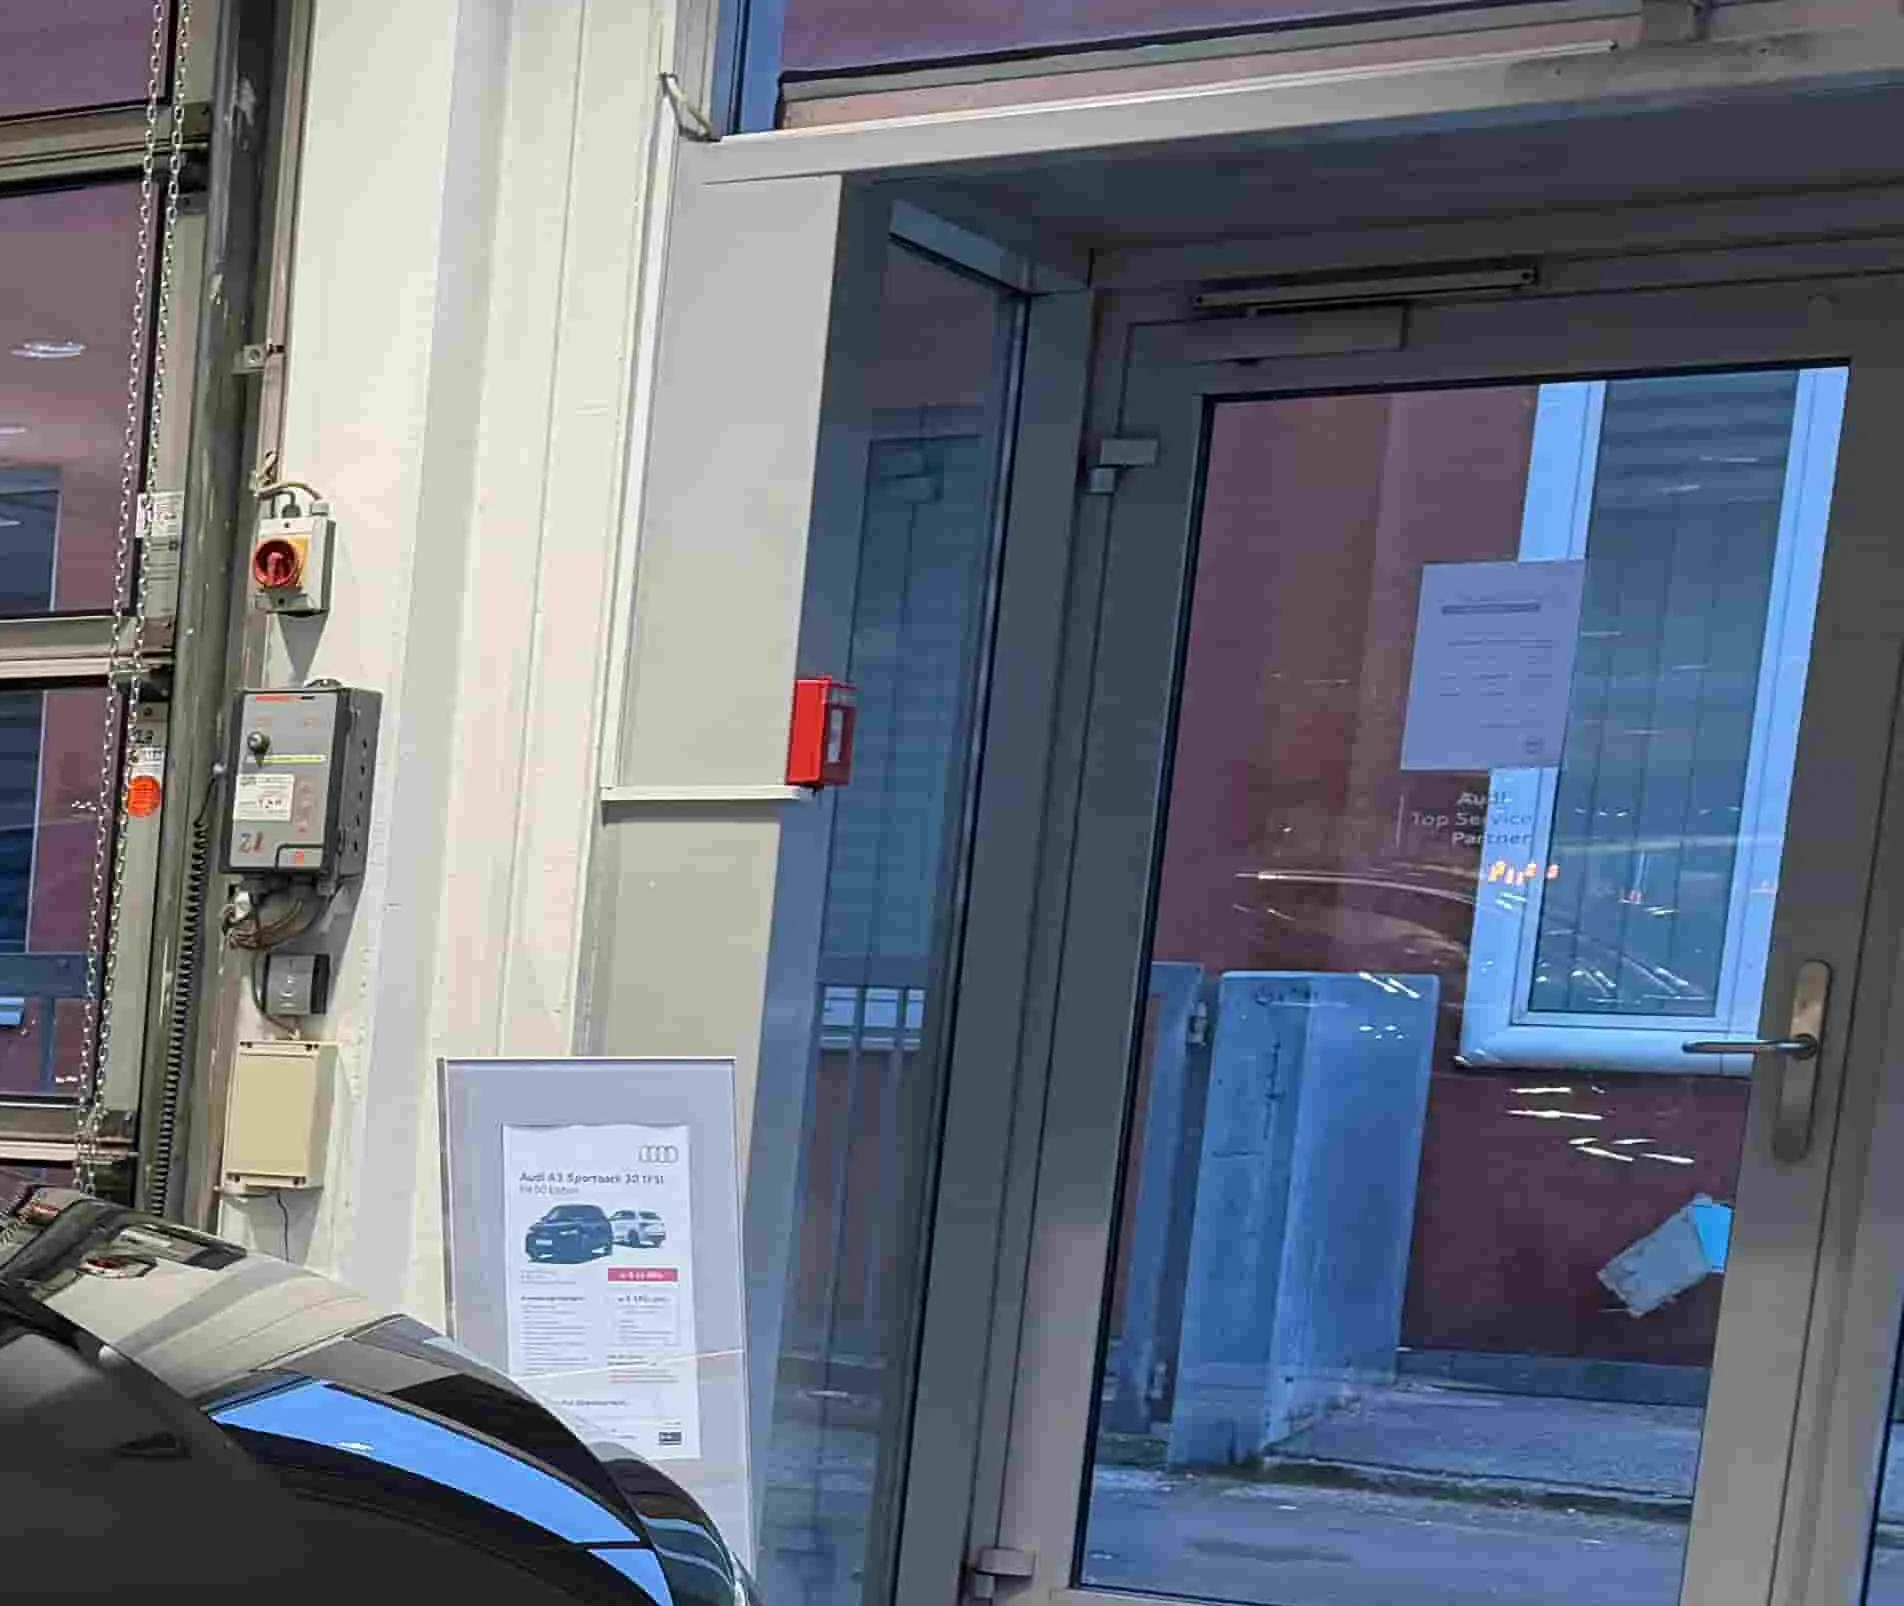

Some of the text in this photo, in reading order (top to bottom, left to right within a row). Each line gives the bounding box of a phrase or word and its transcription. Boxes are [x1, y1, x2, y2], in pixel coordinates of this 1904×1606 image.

[1411, 812, 1449, 829] Top
[1452, 832, 1533, 847] Partner
[519, 1172, 545, 1183] Audi
[548, 1173, 563, 1183] A3
[567, 1173, 621, 1185] Sportback
